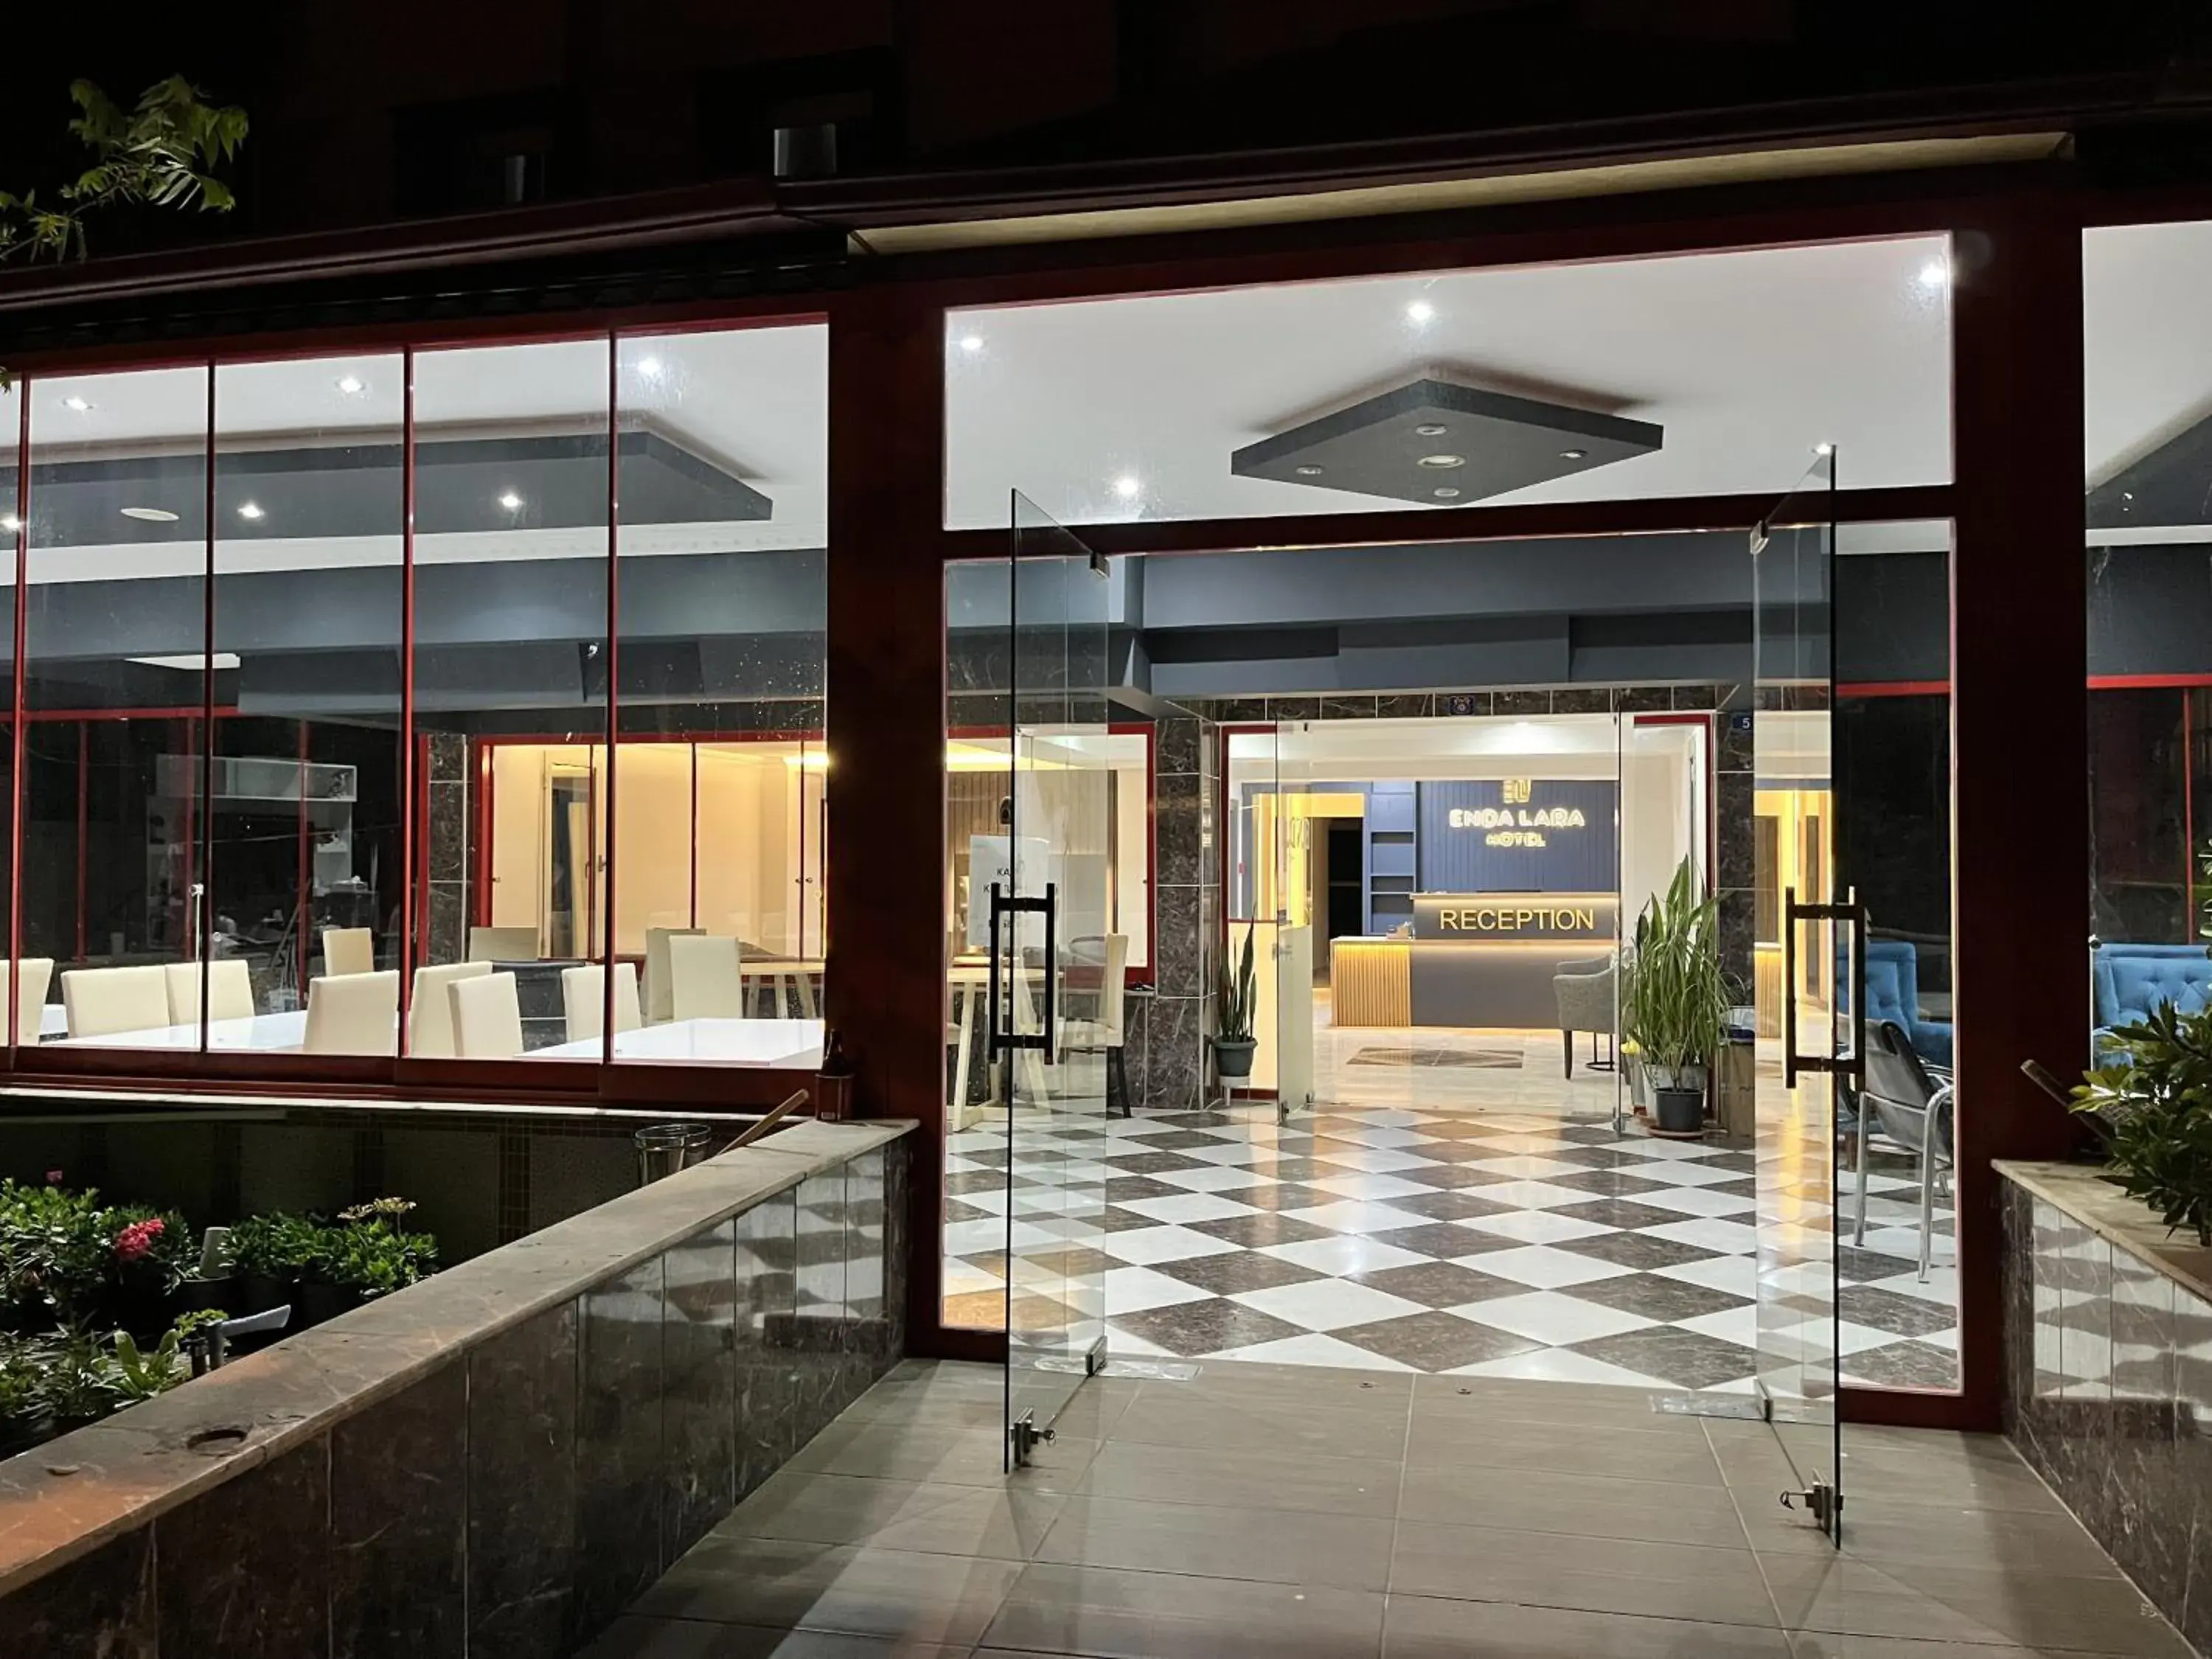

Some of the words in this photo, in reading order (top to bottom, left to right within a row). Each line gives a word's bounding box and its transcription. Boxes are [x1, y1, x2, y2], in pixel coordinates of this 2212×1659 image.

[1742, 717, 1750, 728] 5
[1449, 808, 1514, 827] ENDA
[1518, 808, 1585, 827] LARA
[1486, 832, 1545, 847] HOTEL
[1440, 909, 1593, 930] RECEPTION
